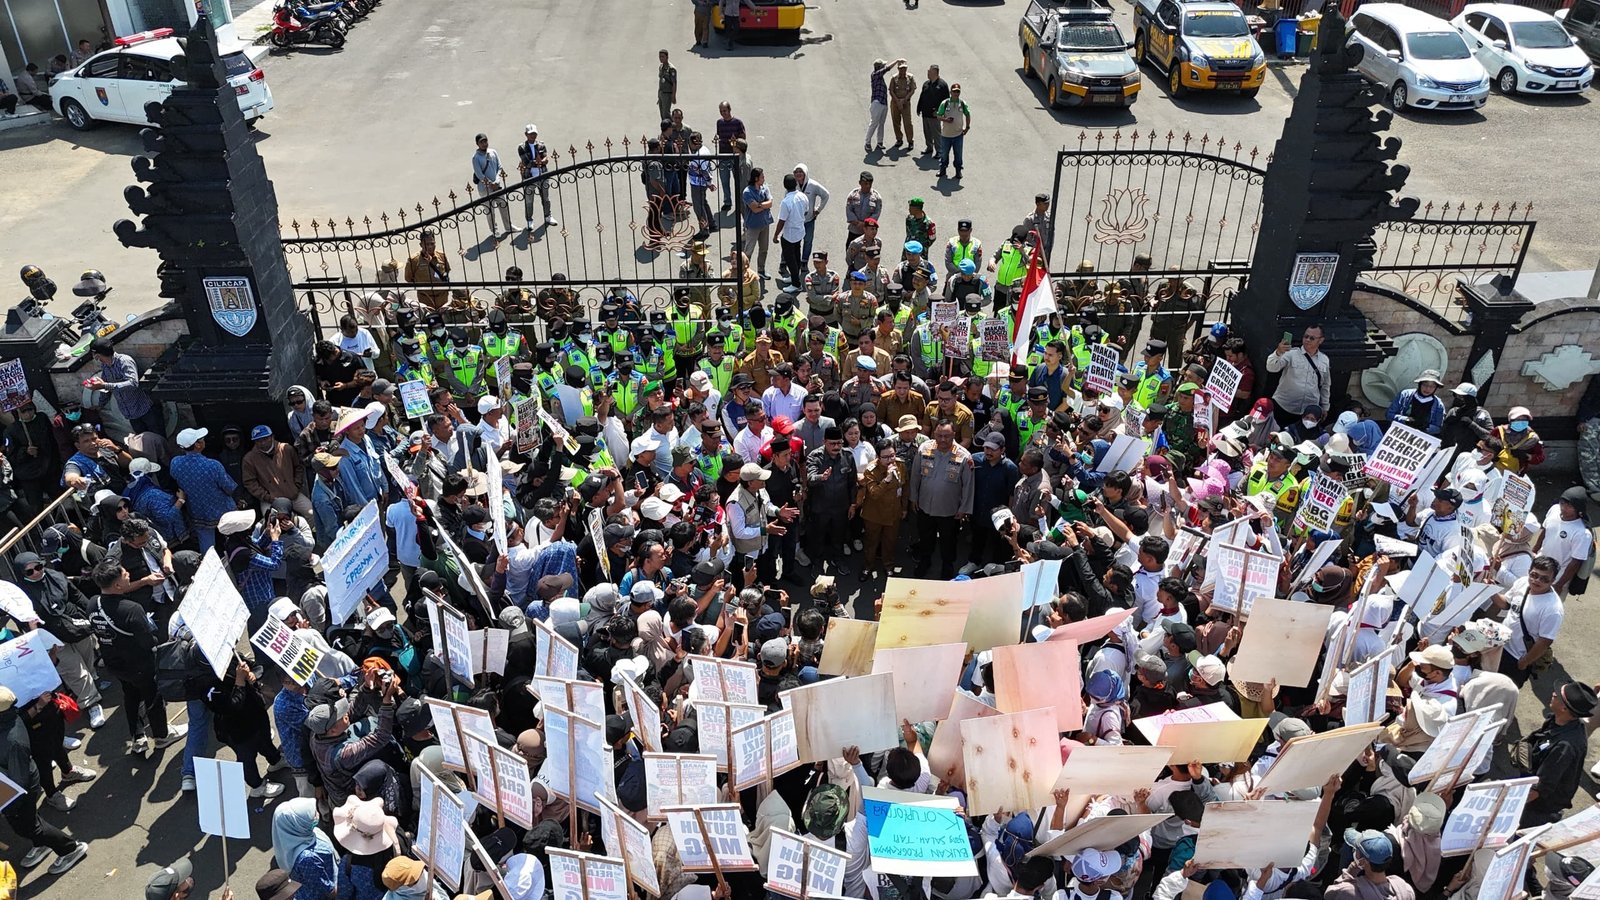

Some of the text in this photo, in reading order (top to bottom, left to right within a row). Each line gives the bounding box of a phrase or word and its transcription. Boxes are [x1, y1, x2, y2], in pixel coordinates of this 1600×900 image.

[1091, 352, 1116, 371] BERGIZI
[1093, 345, 1116, 361] MAKAN
[1091, 365, 1114, 381] GRATIS
[1213, 365, 1236, 390] BERGIZI
[1217, 360, 1238, 381] MAKAN
[1211, 375, 1233, 396] GRATIS
[1382, 436, 1426, 462] BERGIZI
[1390, 426, 1432, 452] MAKAN
[1369, 460, 1414, 480] LANJUTKAN
[1376, 449, 1419, 472] GRATIS
[292, 647, 319, 681] MBG
[931, 848, 969, 858] BUKAN
